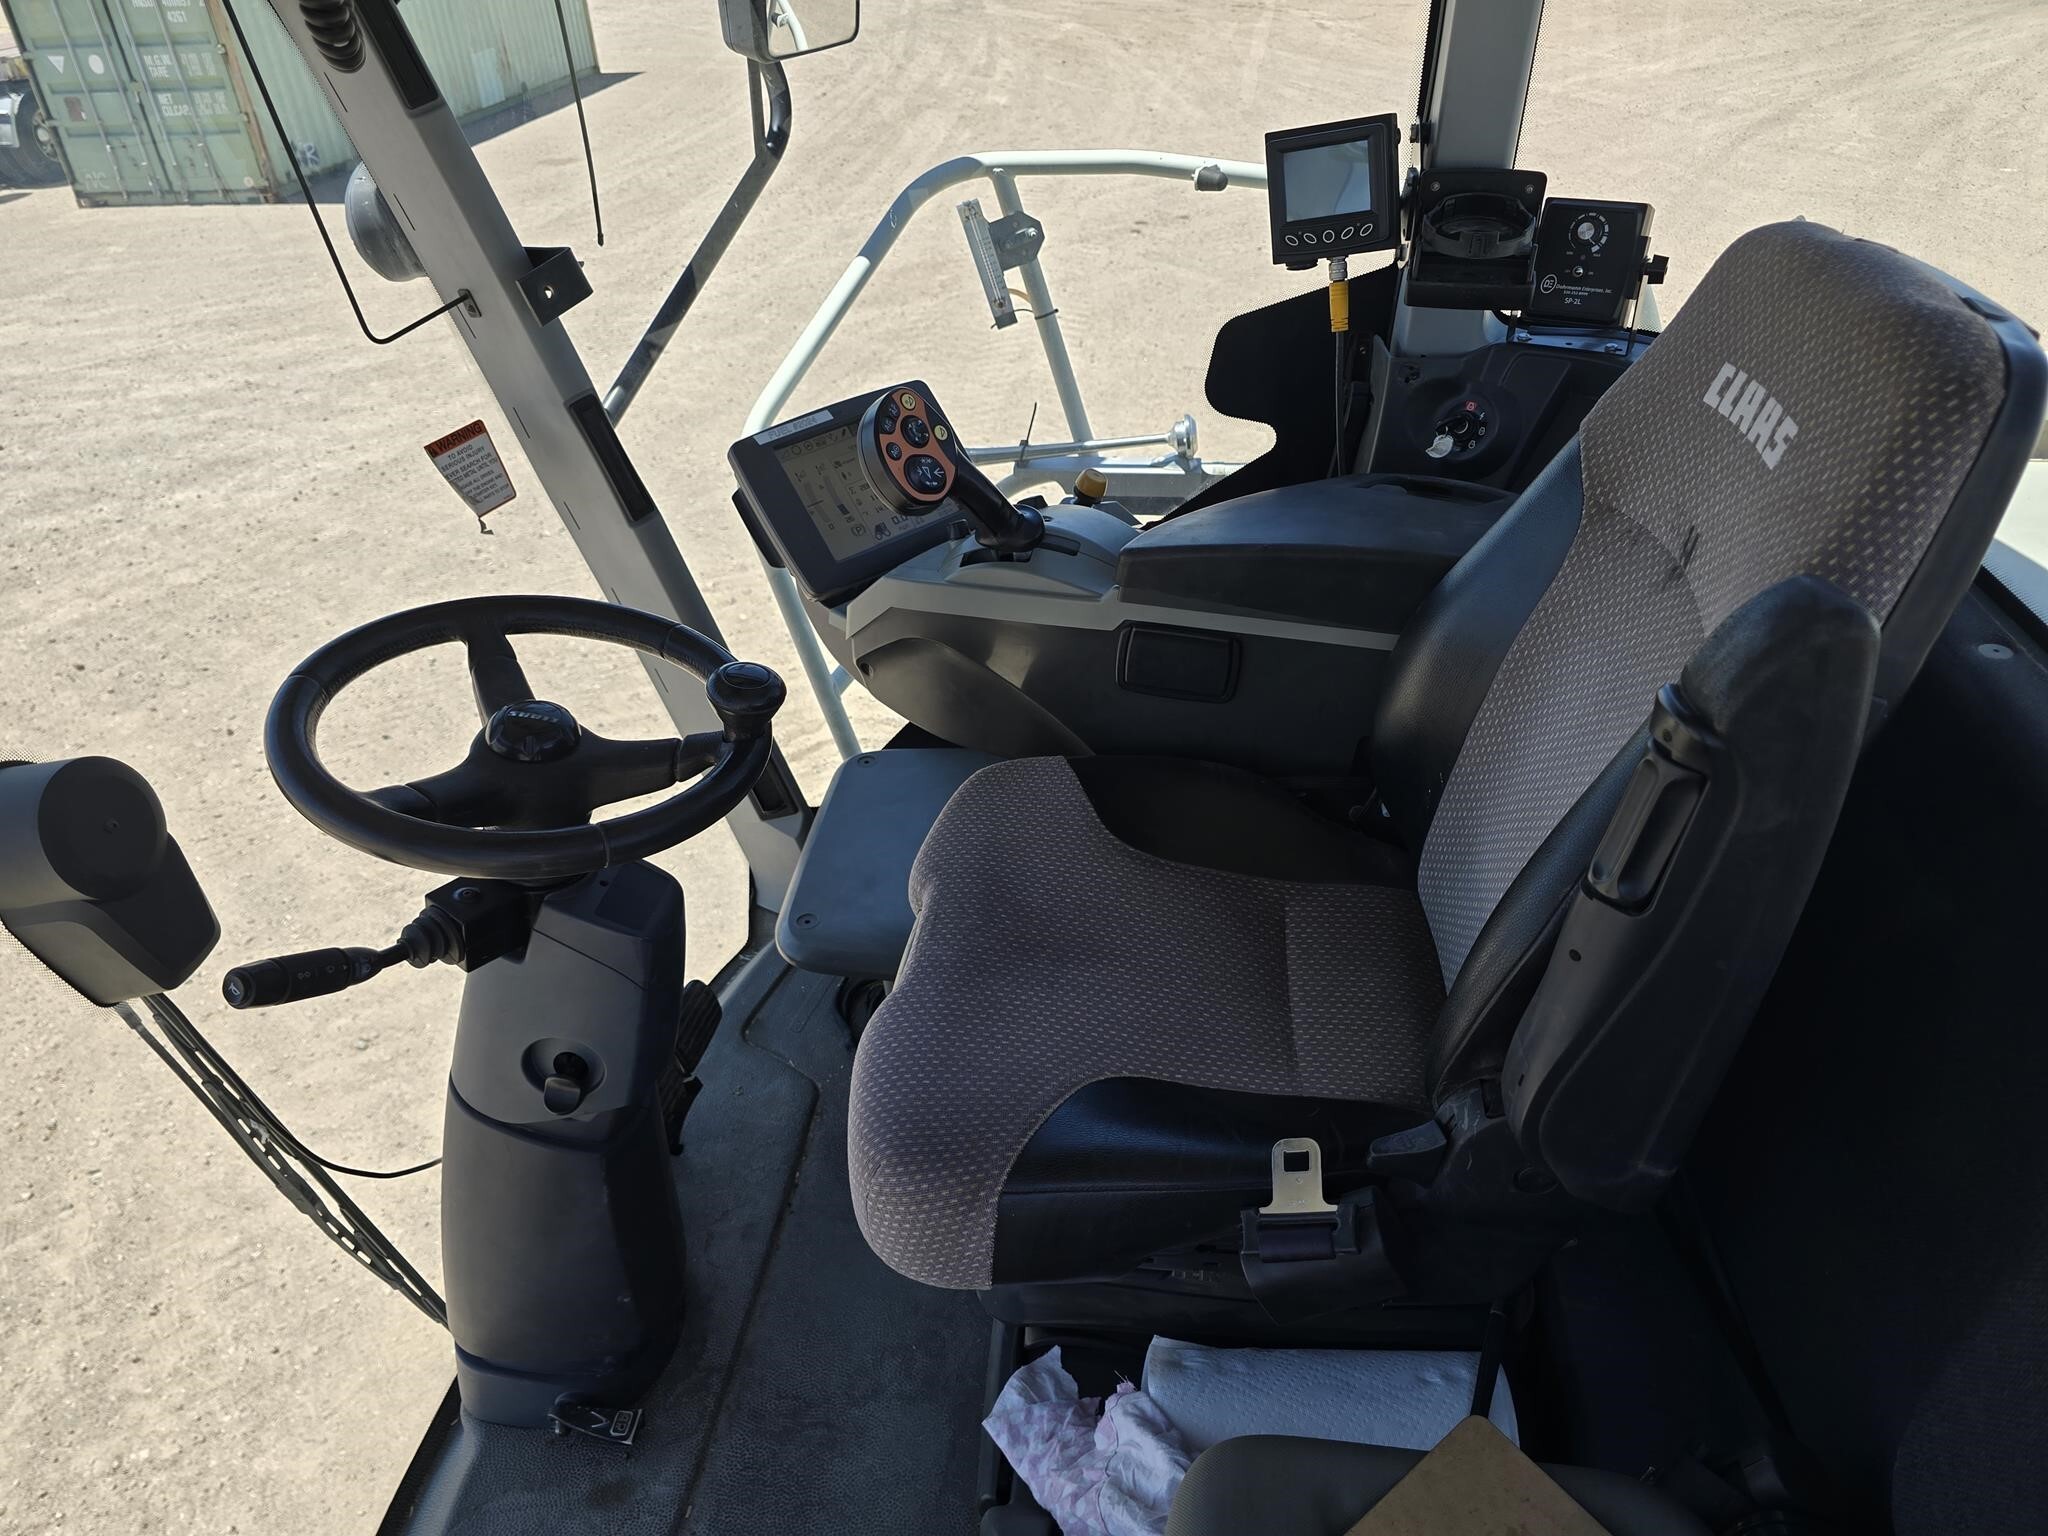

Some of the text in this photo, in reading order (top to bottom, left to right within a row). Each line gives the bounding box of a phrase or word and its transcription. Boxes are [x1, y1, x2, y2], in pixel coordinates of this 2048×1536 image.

[157, 93, 173, 105] NET
[1703, 361, 1799, 470] CLAAS
[436, 422, 483, 453] WARNING
[767, 426, 792, 440] FUEL
[441, 446, 485, 472] SERIOUS INJURY
[456, 444, 473, 456] AVOID
[446, 452, 492, 480] EVER SEARCH FOR
